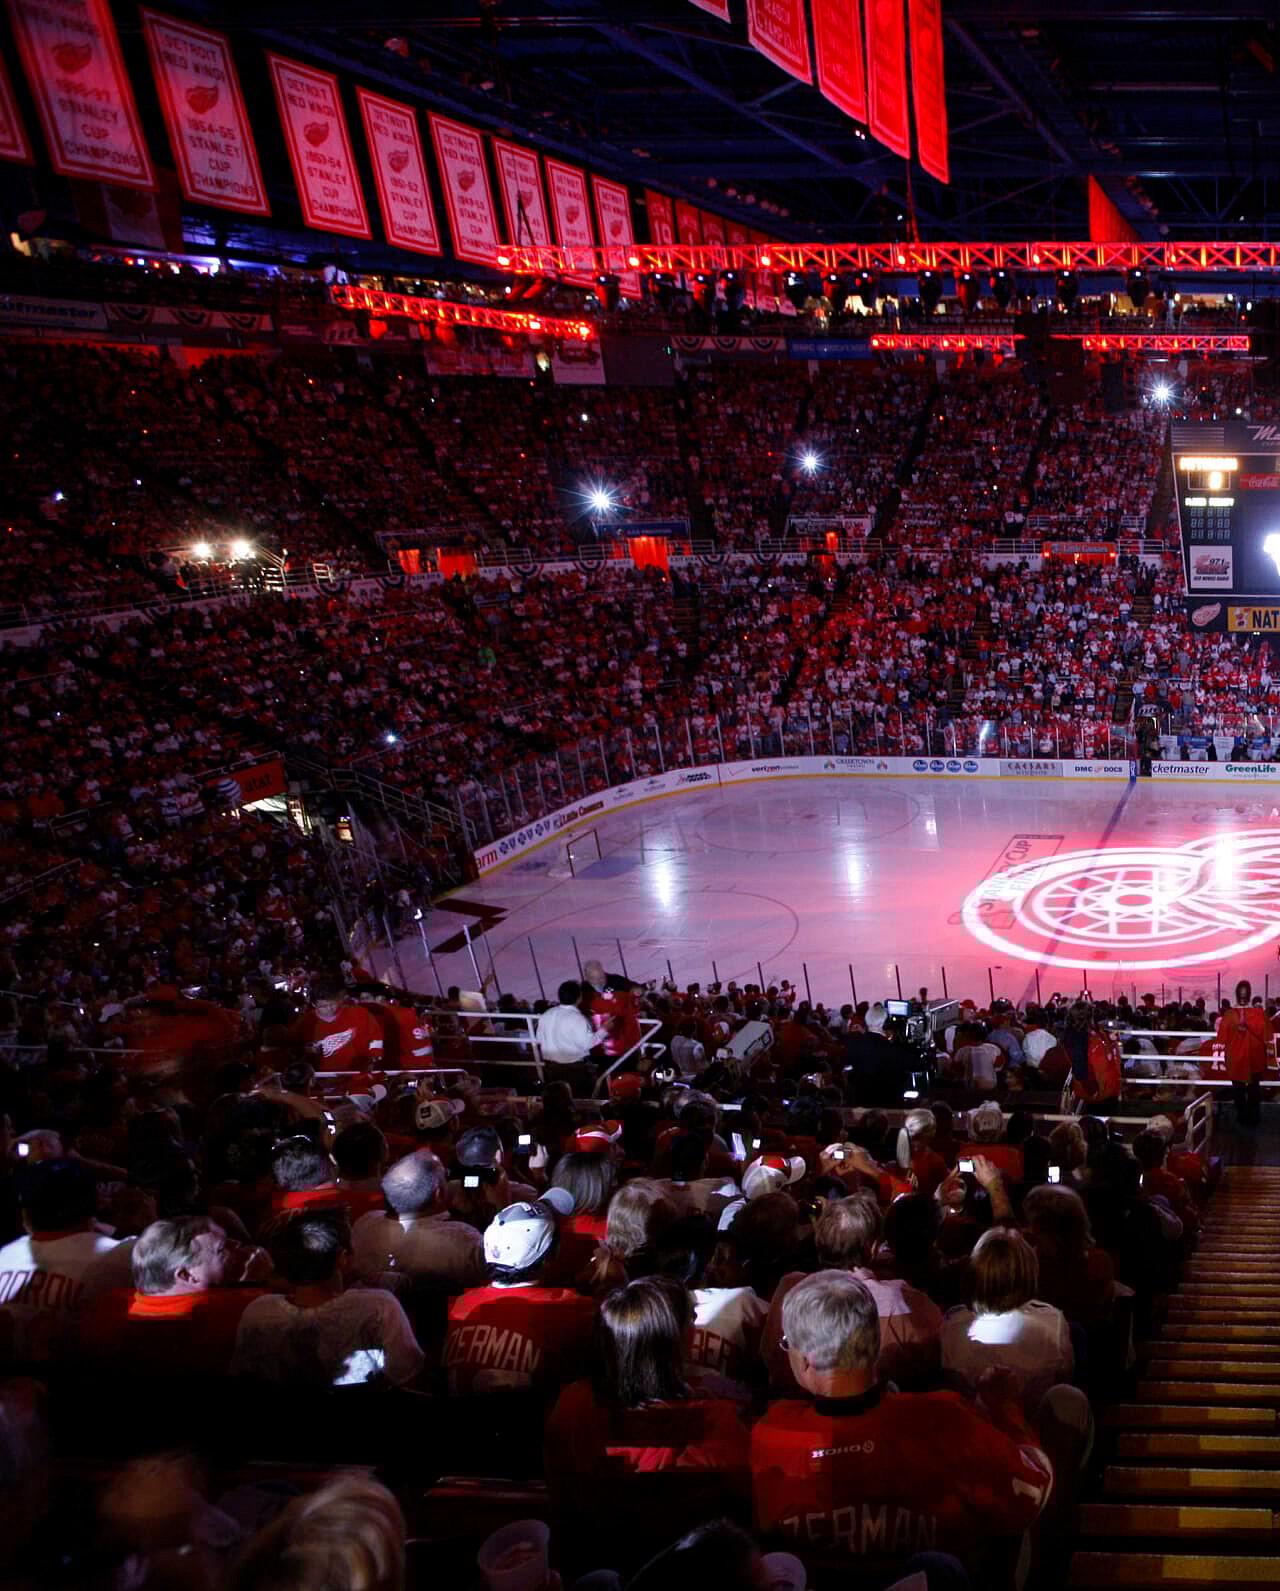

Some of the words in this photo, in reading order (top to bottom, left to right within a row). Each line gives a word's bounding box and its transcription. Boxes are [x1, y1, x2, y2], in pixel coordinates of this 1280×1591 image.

[288, 94, 306, 109] RED
[82, 124, 109, 139] CUP
[63, 140, 140, 168] CHAMPIONS
[189, 136, 240, 158] STANLEY
[209, 158, 231, 172] CUP
[307, 166, 347, 186] STANLEY
[192, 171, 257, 197] CHAMPIONS
[322, 186, 340, 200] CUP
[311, 199, 361, 218] CHAMPIONS
[751, 764, 782, 774] verizon
[1008, 762, 1056, 770] CAESARS
[1225, 763, 1277, 774] GreenLife
[1004, 840, 1032, 862] CUP
